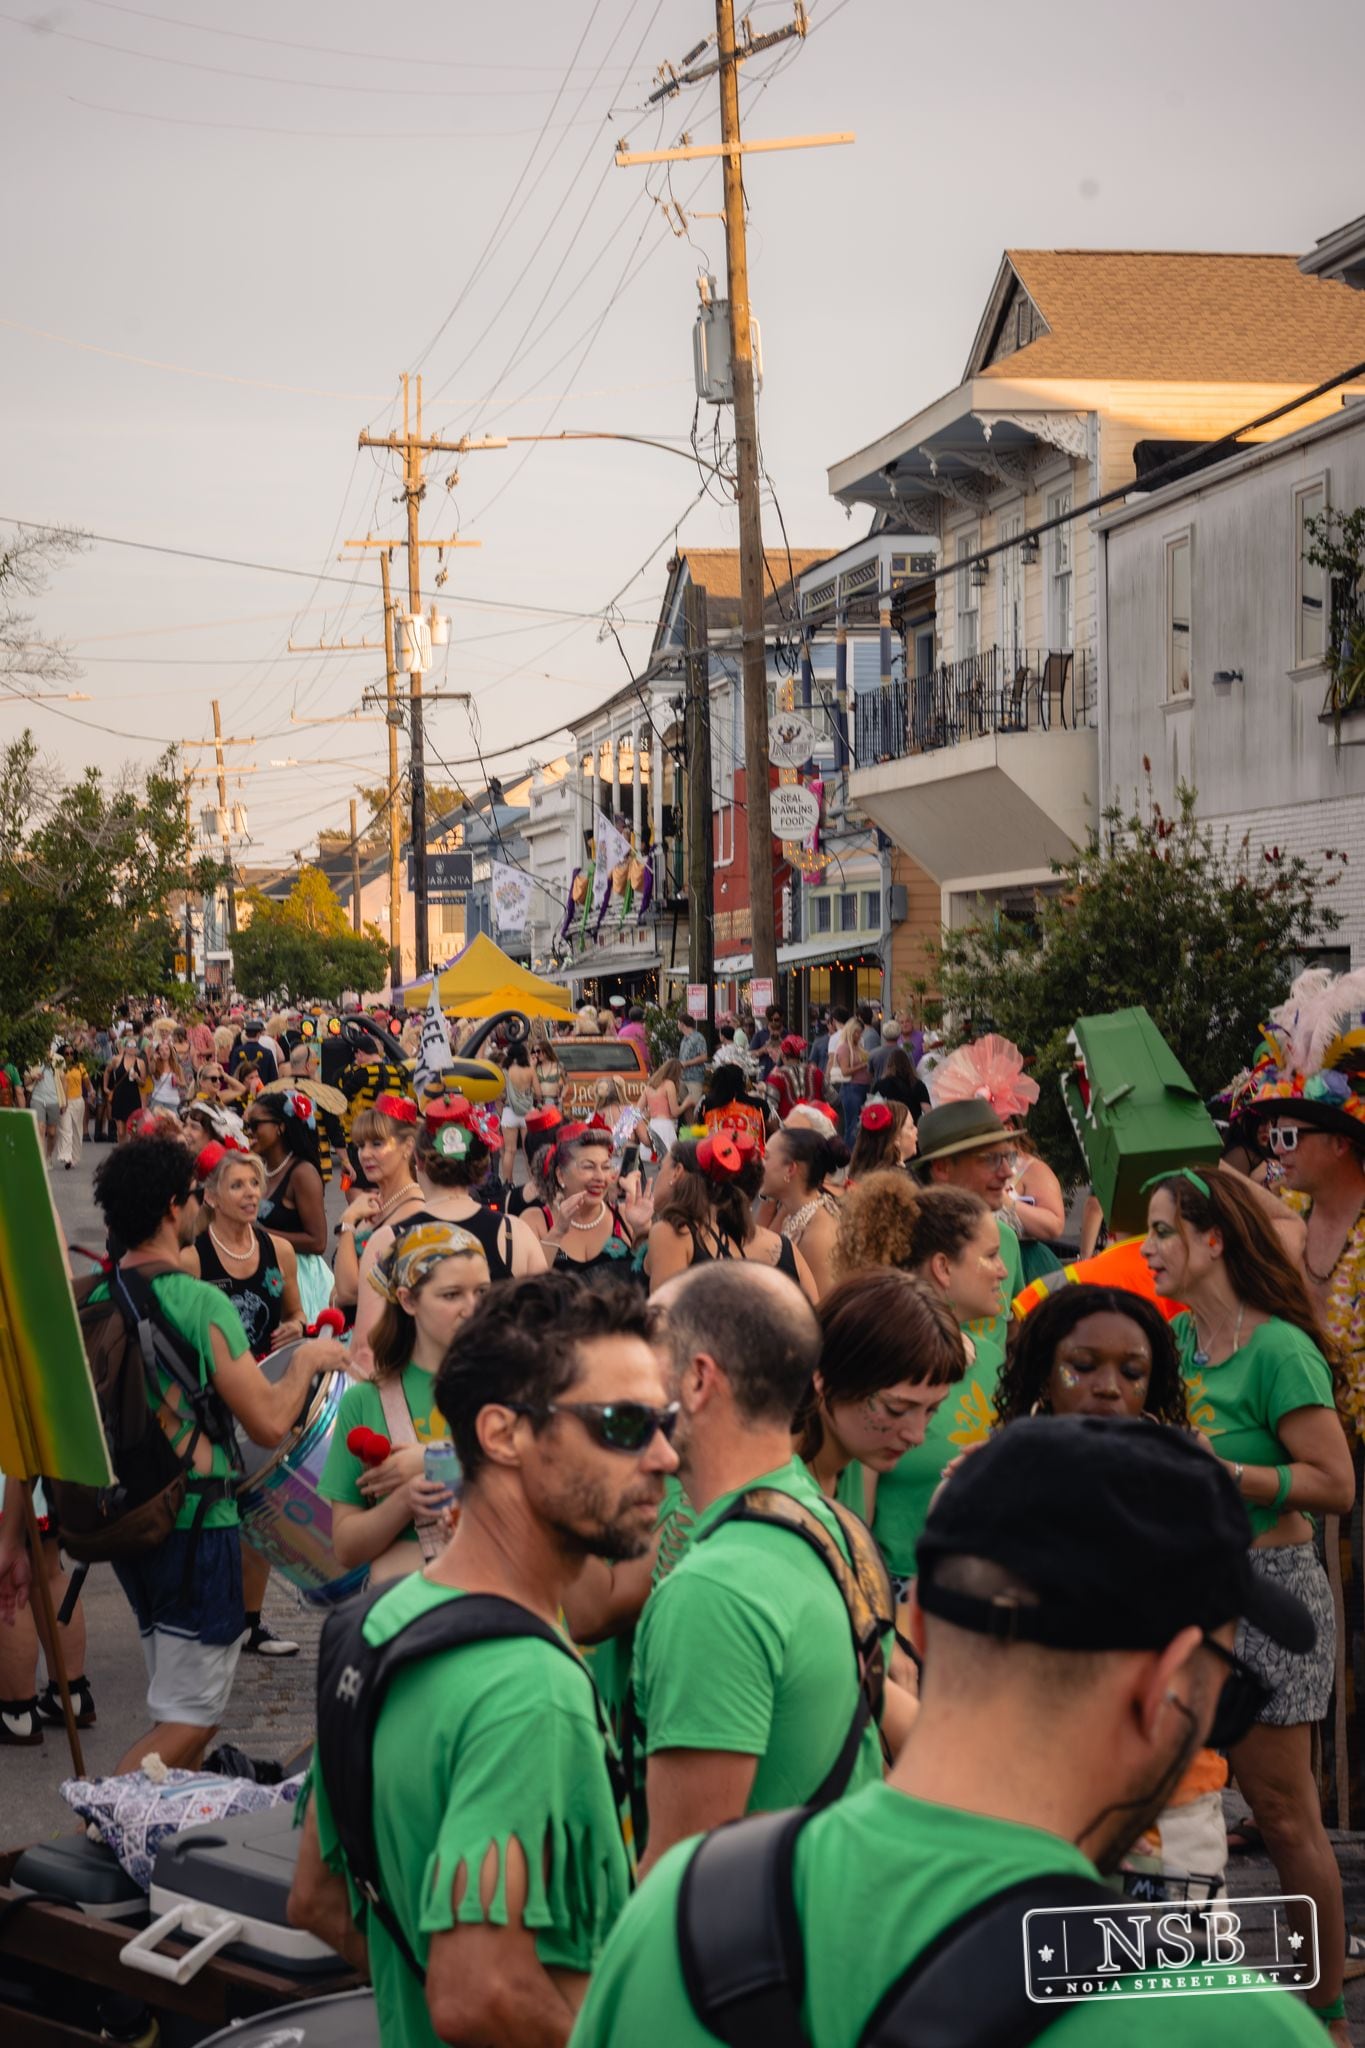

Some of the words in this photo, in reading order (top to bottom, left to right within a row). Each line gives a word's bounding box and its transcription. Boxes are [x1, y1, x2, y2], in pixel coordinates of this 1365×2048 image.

[780, 793, 802, 804] REAL
[771, 805, 813, 816] N'AWLINS
[780, 816, 805, 827] FOOD
